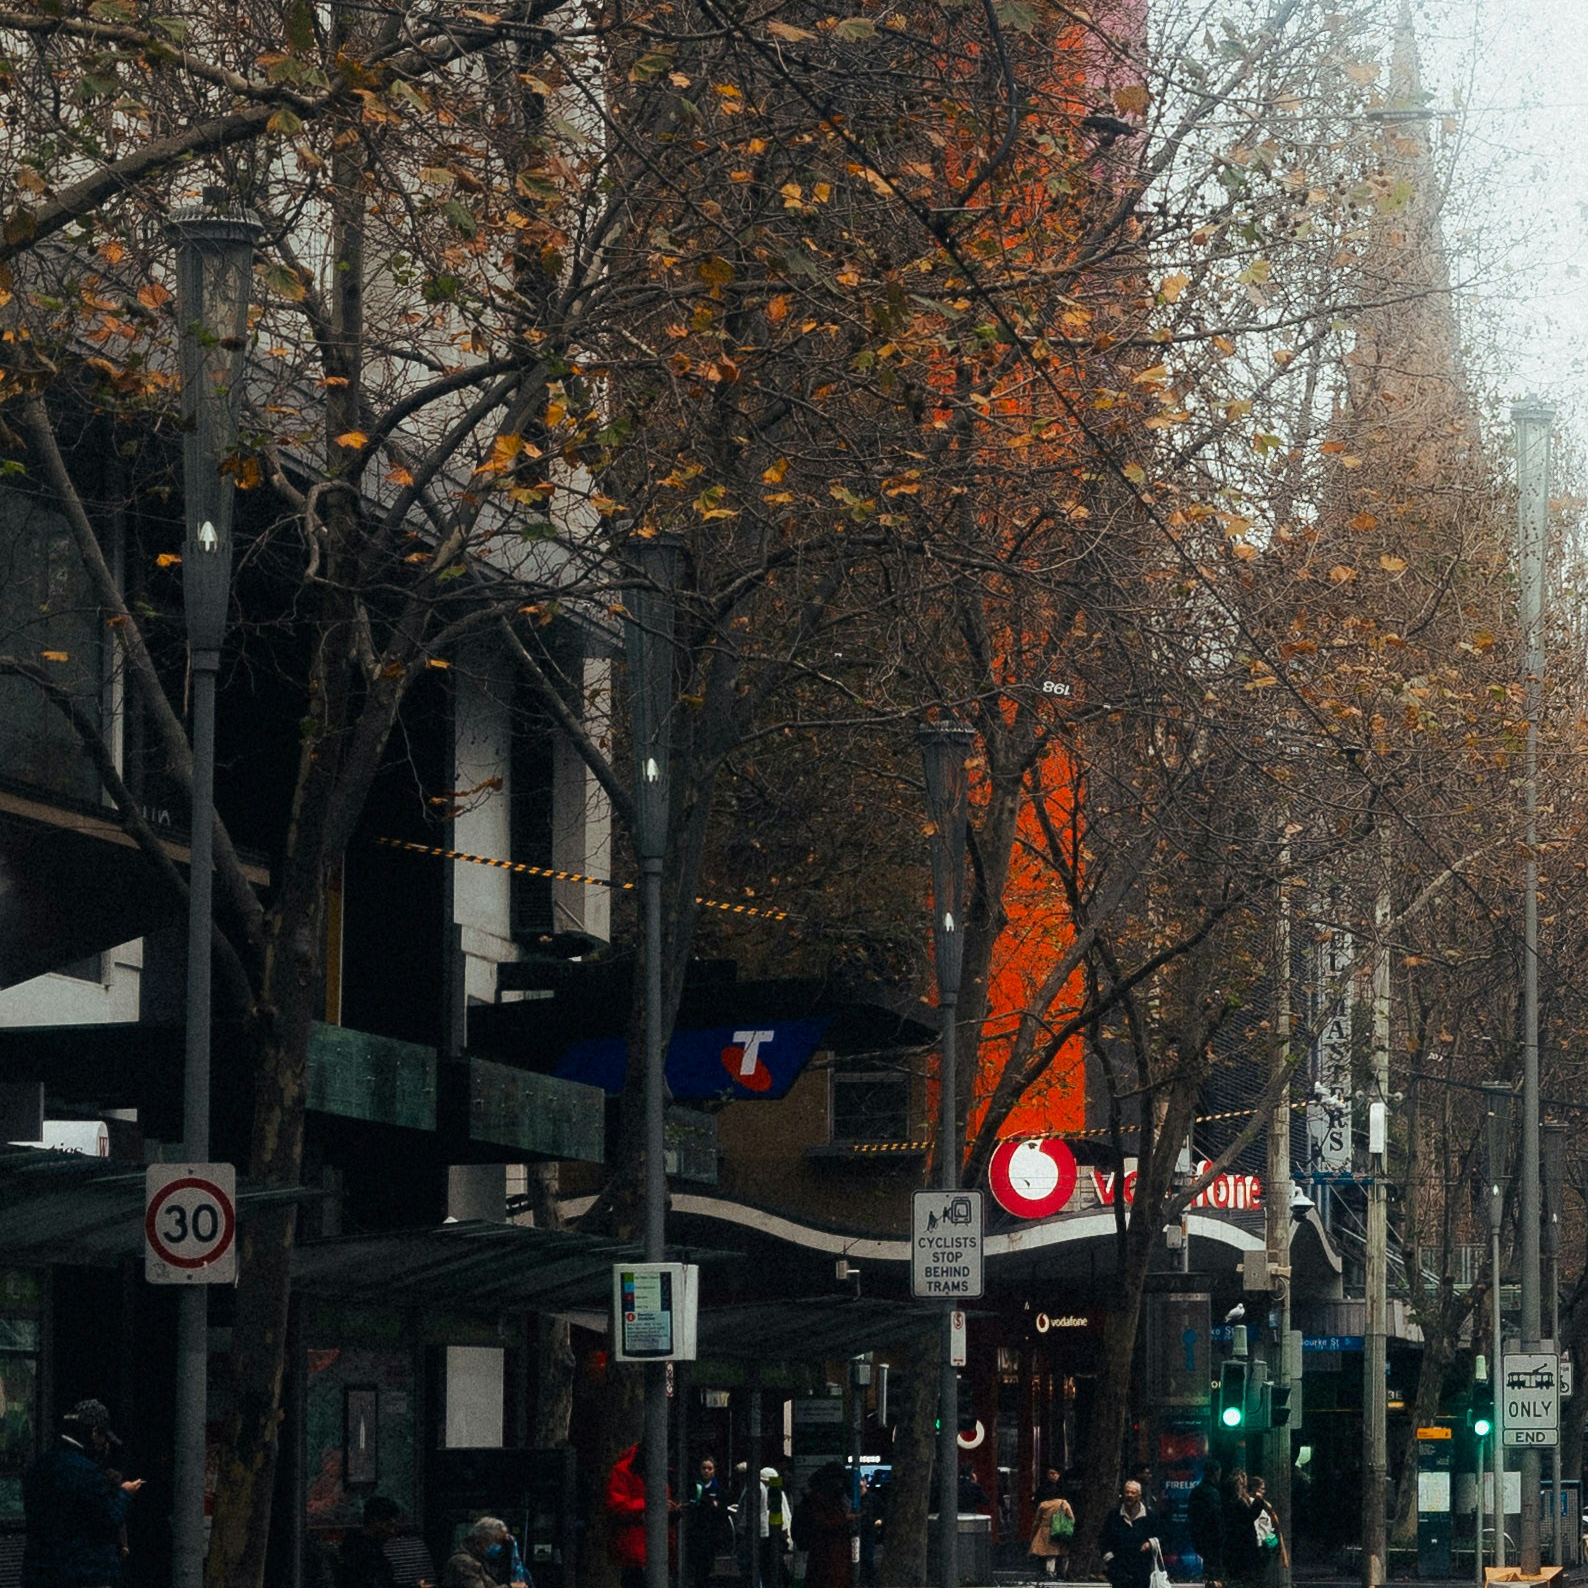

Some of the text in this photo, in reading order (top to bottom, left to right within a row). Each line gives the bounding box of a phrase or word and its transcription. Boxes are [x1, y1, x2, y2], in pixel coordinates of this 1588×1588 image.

[163, 1203, 218, 1244] 30
[918, 1237, 977, 1248] CYCLISTS
[932, 1251, 963, 1263] STOP
[924, 1266, 970, 1278] BEHIND
[927, 1281, 969, 1292] TRAMS
[1050, 1315, 1088, 1327] vodafone
[1301, 1338, 1327, 1346] ourke
[1508, 1401, 1552, 1418] ONLY
[1515, 1431, 1546, 1443] END
